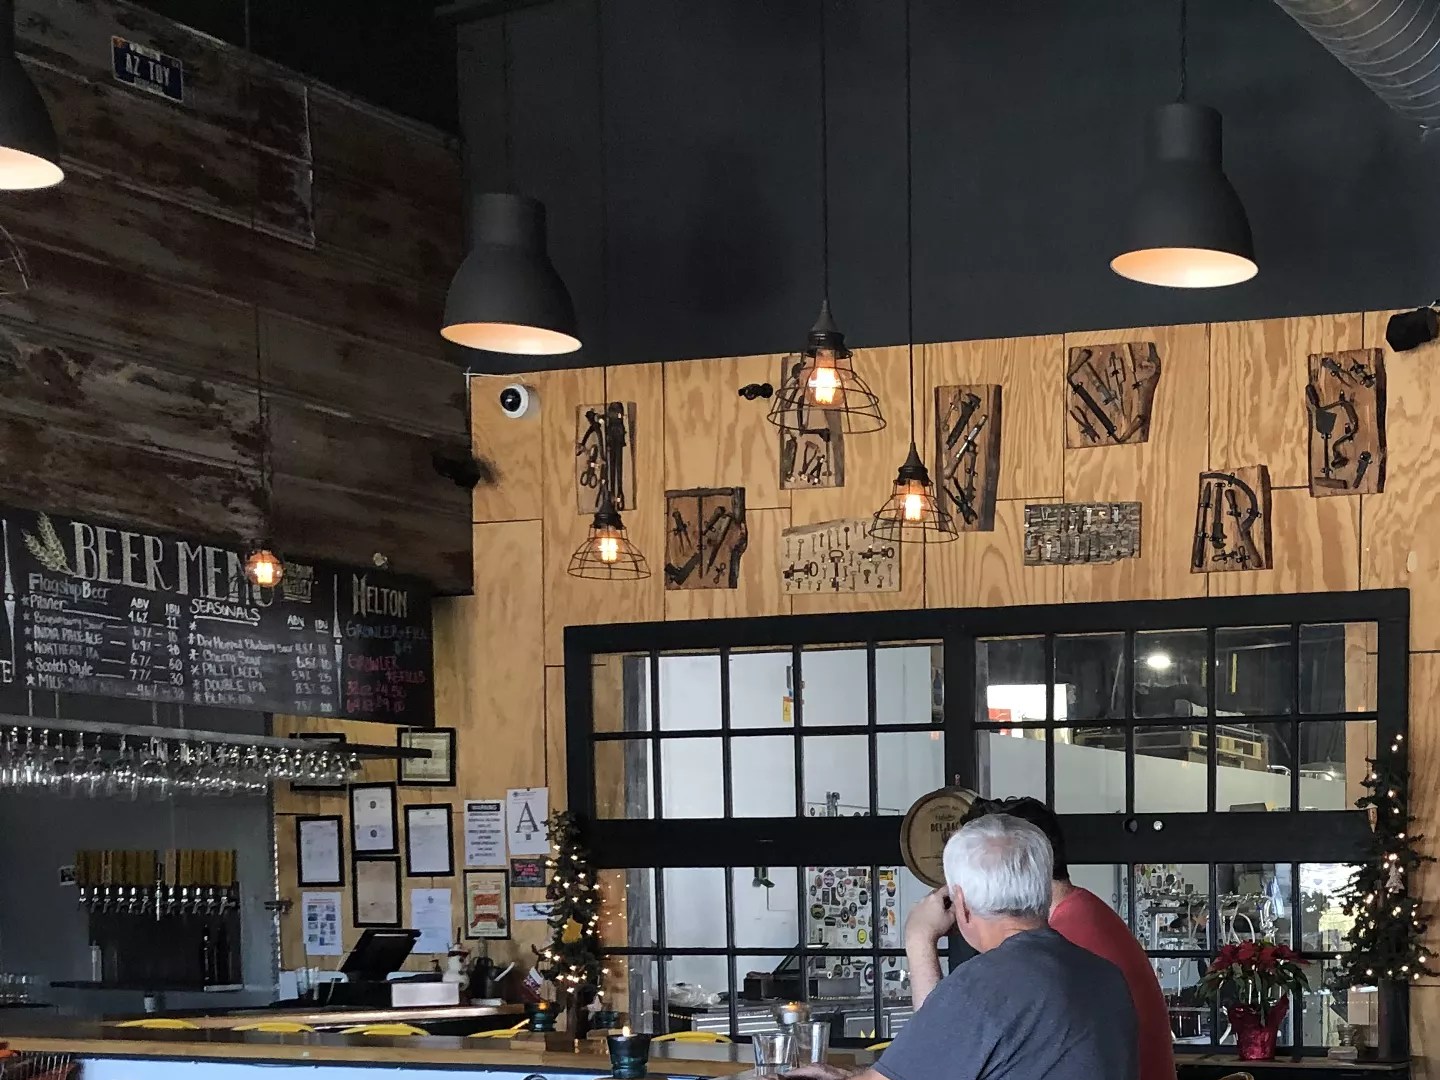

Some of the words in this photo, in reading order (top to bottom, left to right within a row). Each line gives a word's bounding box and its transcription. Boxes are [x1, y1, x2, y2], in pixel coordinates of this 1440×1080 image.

[70, 520, 173, 593] BEER
[352, 572, 409, 619] HELTON
[515, 801, 540, 834] A
